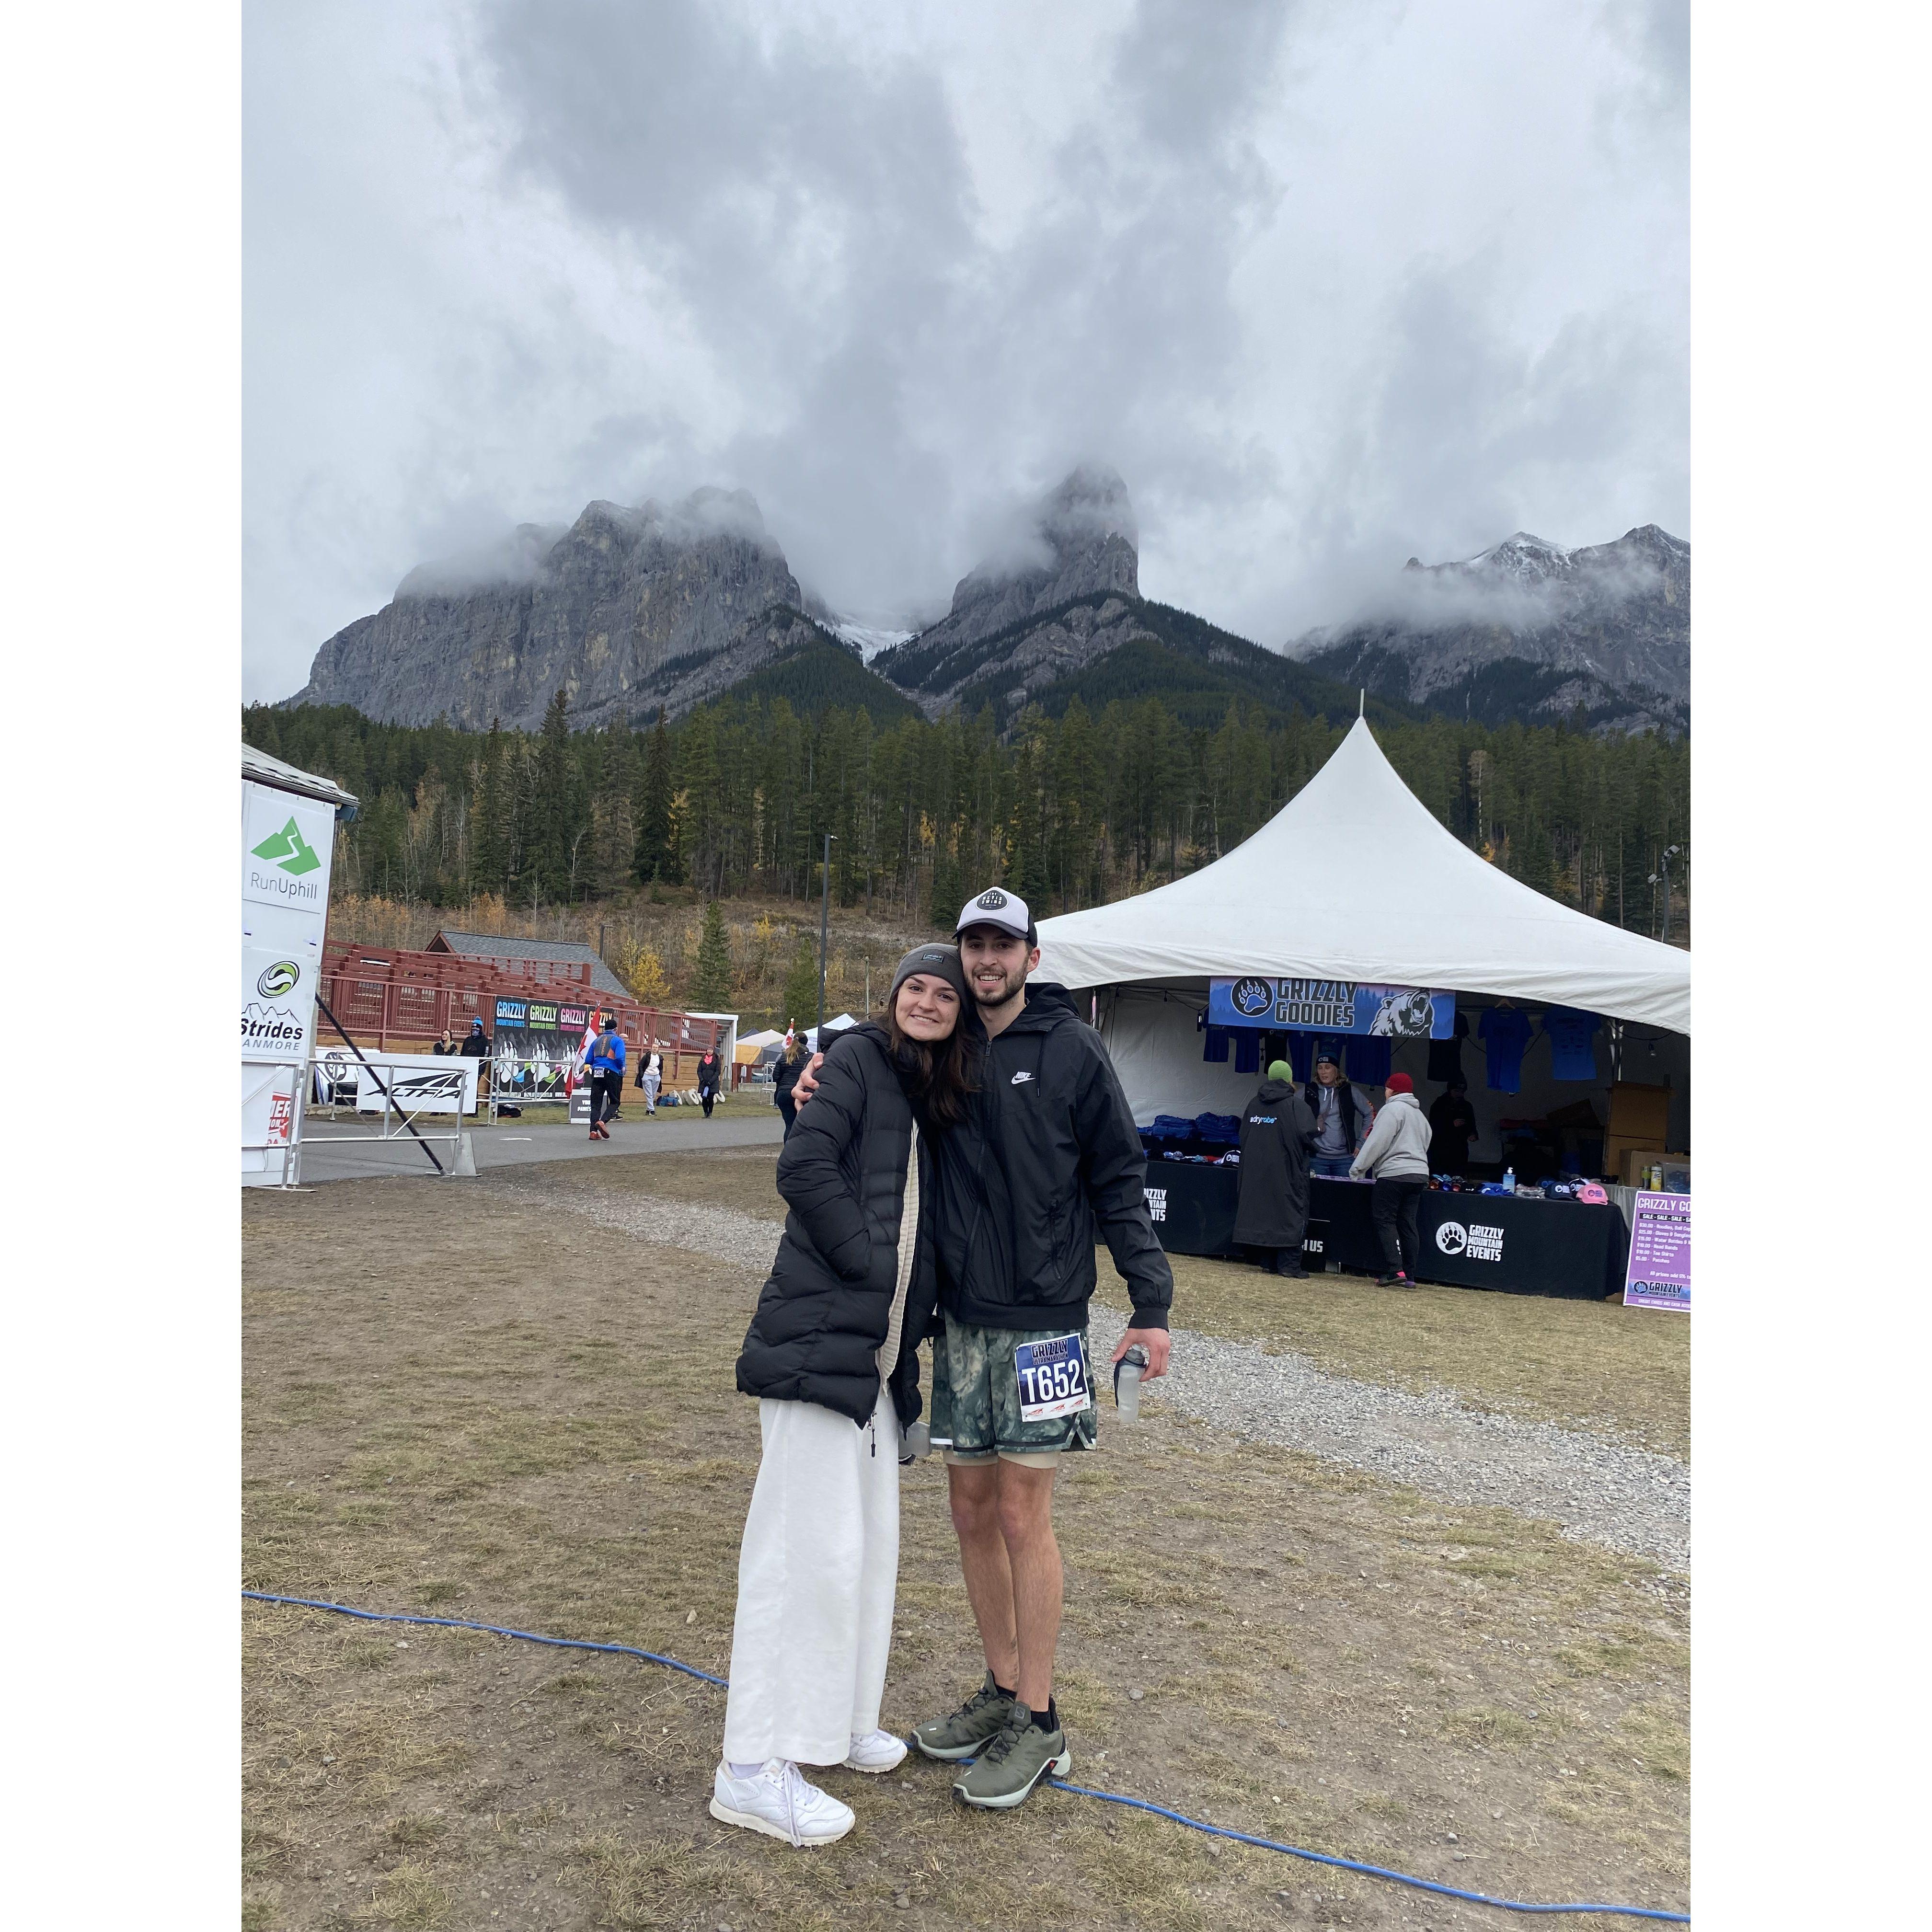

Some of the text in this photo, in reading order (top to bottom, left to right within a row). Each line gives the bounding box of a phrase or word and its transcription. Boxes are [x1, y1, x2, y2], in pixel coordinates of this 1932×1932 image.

[251, 872, 317, 899] RunUphill
[1276, 978, 1357, 1004] GRIZZLY
[496, 1001, 526, 1019] GRIZZLY
[529, 1005, 557, 1022] GRIZZLY
[561, 1008, 586, 1024] GRIZZLY
[1275, 1000, 1355, 1028] GOODIES
[242, 1018, 303, 1040] Strides
[1015, 1071, 1032, 1079] NIKE
[1638, 1197, 1677, 1211] GRIZZLY
[1469, 1224, 1504, 1240] GRIZZLY
[1309, 1240, 1323, 1253] US
[1467, 1235, 1503, 1249] MOUNTAIN
[1466, 1244, 1502, 1262] EVENTS
[1649, 1282, 1682, 1294] GRIZZLY
[1031, 1338, 1069, 1358] GRIZZLY
[1032, 1352, 1069, 1366] ULTRAMARATHON
[1021, 1359, 1083, 1403] T652
